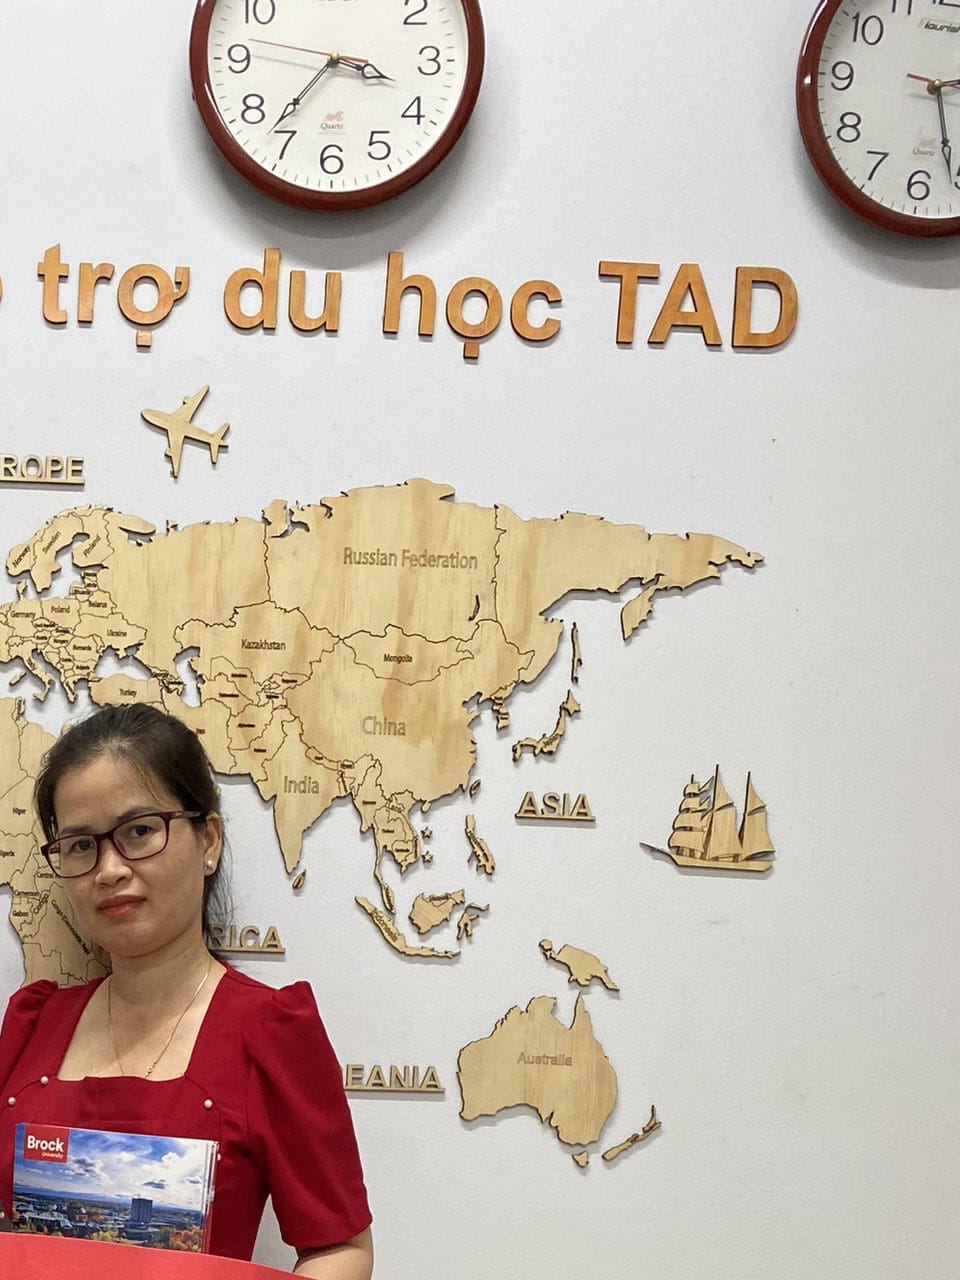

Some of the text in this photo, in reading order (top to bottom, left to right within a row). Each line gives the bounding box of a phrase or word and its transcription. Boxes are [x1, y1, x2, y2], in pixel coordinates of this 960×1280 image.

[244, 0, 275, 24] 10
[403, 0, 428, 25] 2
[852, 12, 884, 45] 10
[227, 44, 251, 73] 9
[417, 46, 441, 75] 3
[831, 61, 854, 91] 9
[241, 94, 265, 124] 8
[401, 96, 425, 125] 4
[836, 112, 861, 142] 8
[274, 131, 297, 160] 7
[319, 145, 344, 174] 6
[367, 131, 391, 160] 5
[867, 150, 889, 181] 7
[907, 170, 932, 200] 6
[37, 243, 191, 348] trợ
[223, 247, 343, 334] du
[383, 251, 562, 360] học
[598, 260, 800, 348] TAD
[343, 547, 478, 570] Russian Federation
[241, 639, 286, 651] Kazakhstan
[361, 715, 407, 738] China
[283, 775, 320, 794] India
[516, 791, 595, 821] ASIA
[206, 924, 285, 953] RICA
[517, 1051, 573, 1067] Australia
[345, 1064, 444, 1092] EANIA
[27, 1134, 64, 1152] Brock
